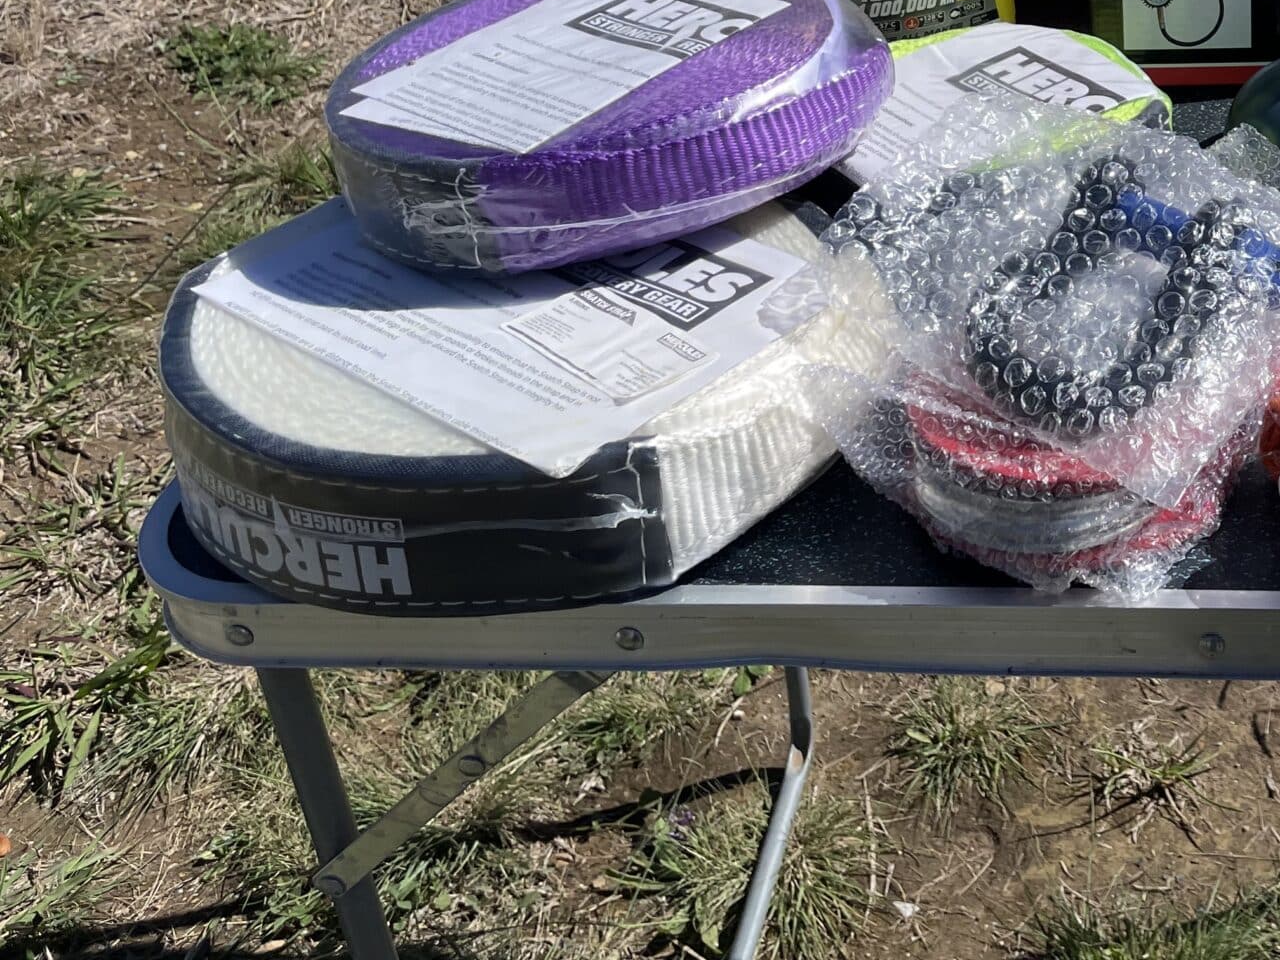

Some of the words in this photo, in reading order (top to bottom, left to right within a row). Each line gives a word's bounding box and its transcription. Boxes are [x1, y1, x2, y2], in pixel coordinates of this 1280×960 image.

[589, 16, 668, 43] STRONGER
[982, 52, 1119, 113] HERC
[643, 289, 697, 317] GEAR
[290, 508, 397, 537] STRONGER
[188, 489, 413, 597] HERCUL
